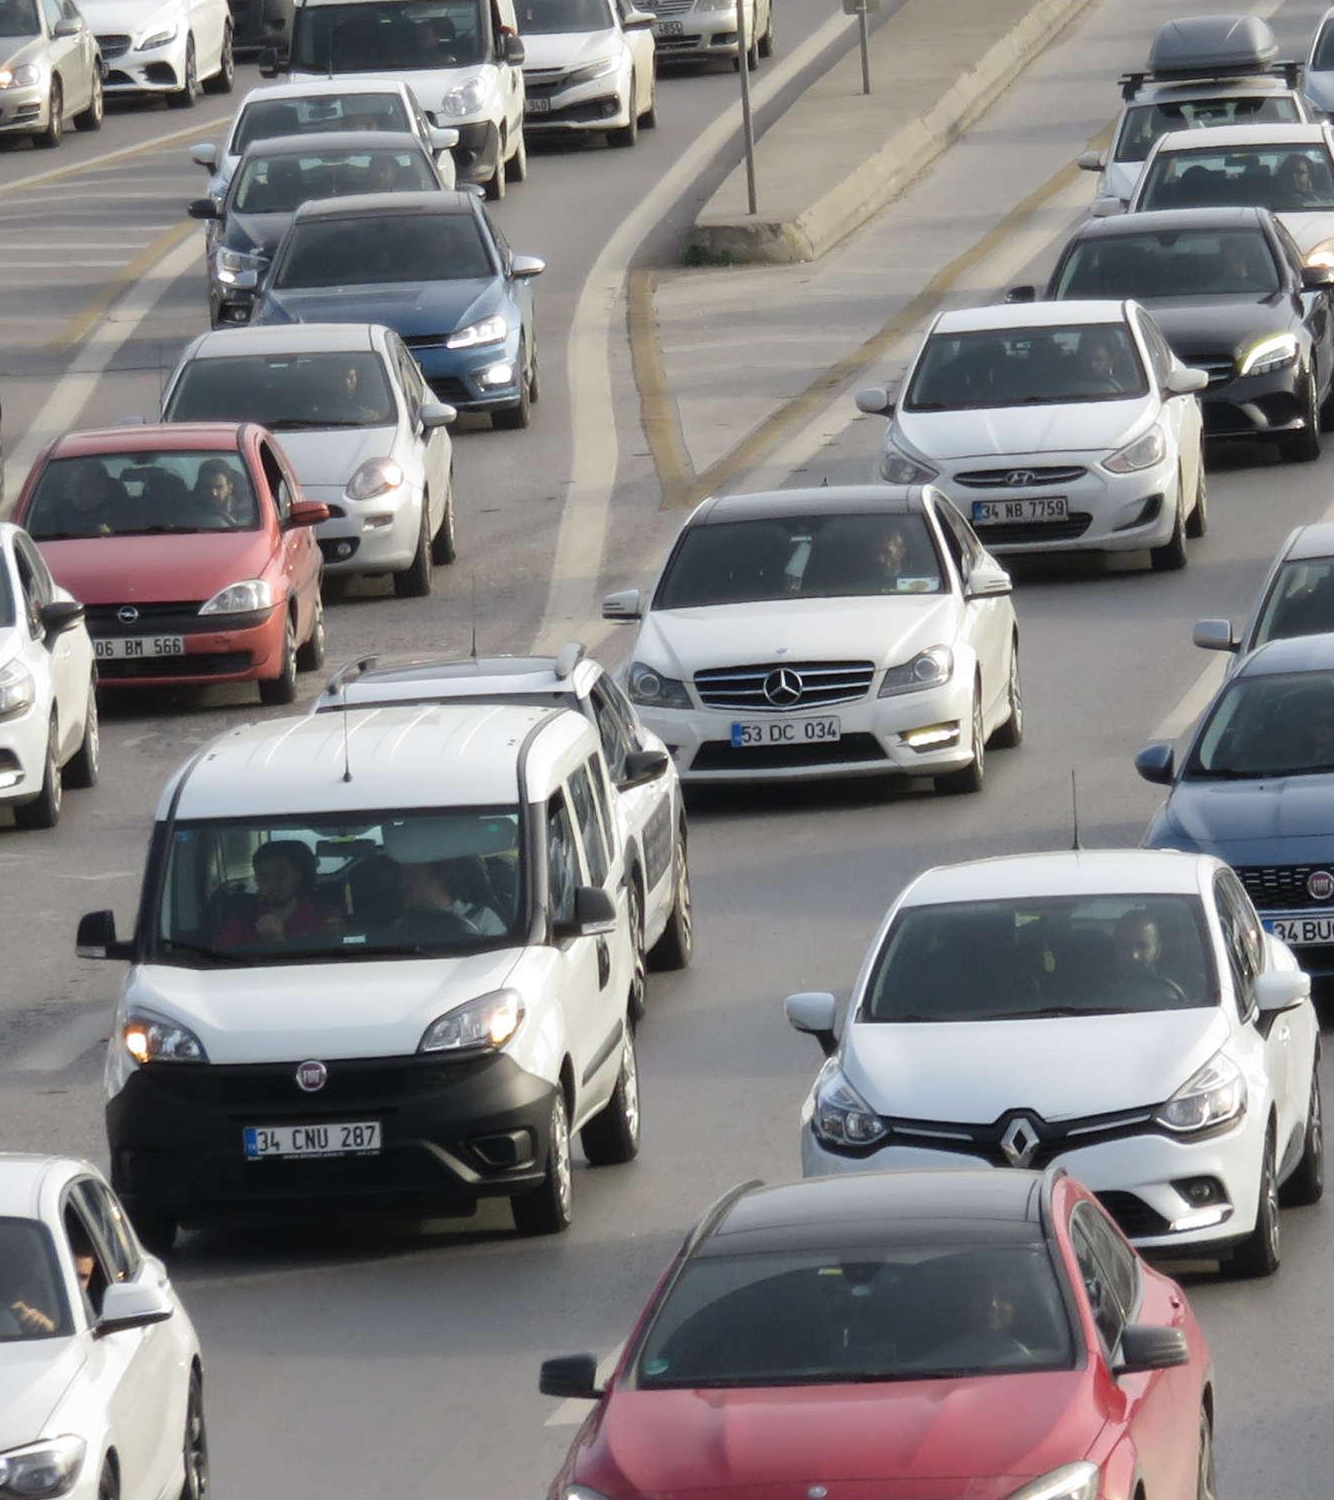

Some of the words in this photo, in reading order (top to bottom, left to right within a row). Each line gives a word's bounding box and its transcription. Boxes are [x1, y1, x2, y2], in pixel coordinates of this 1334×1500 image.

[982, 505, 999, 520] 34
[1005, 503, 1022, 518] NB
[1028, 499, 1064, 516] 7759
[96, 641, 114, 656] 06
[125, 639, 143, 655] BM
[154, 637, 181, 654] 566
[741, 725, 762, 742] 53
[770, 724, 793, 741] DC
[804, 721, 836, 739] 034
[1273, 921, 1299, 940] 34
[257, 1131, 280, 1152] 34
[292, 1128, 328, 1150] CNU
[341, 1125, 375, 1148] 287
